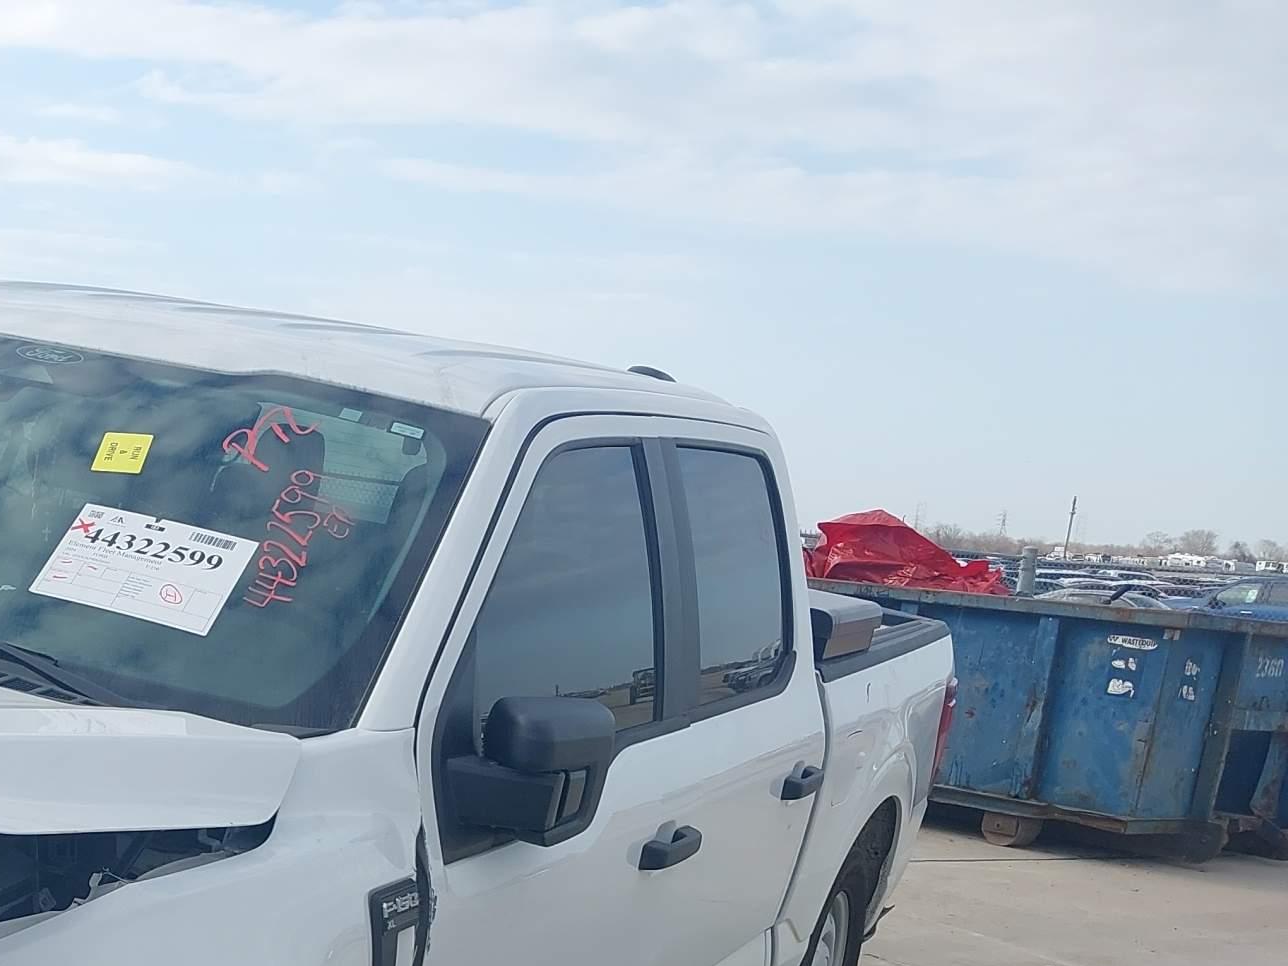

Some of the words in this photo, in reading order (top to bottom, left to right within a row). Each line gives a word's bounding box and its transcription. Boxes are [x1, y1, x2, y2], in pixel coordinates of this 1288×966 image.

[103, 442, 119, 461] DRIVE
[129, 446, 143, 461] RUN
[242, 470, 330, 607] 44322599
[84, 527, 223, 570] 44322599
[387, 919, 398, 931] XL
